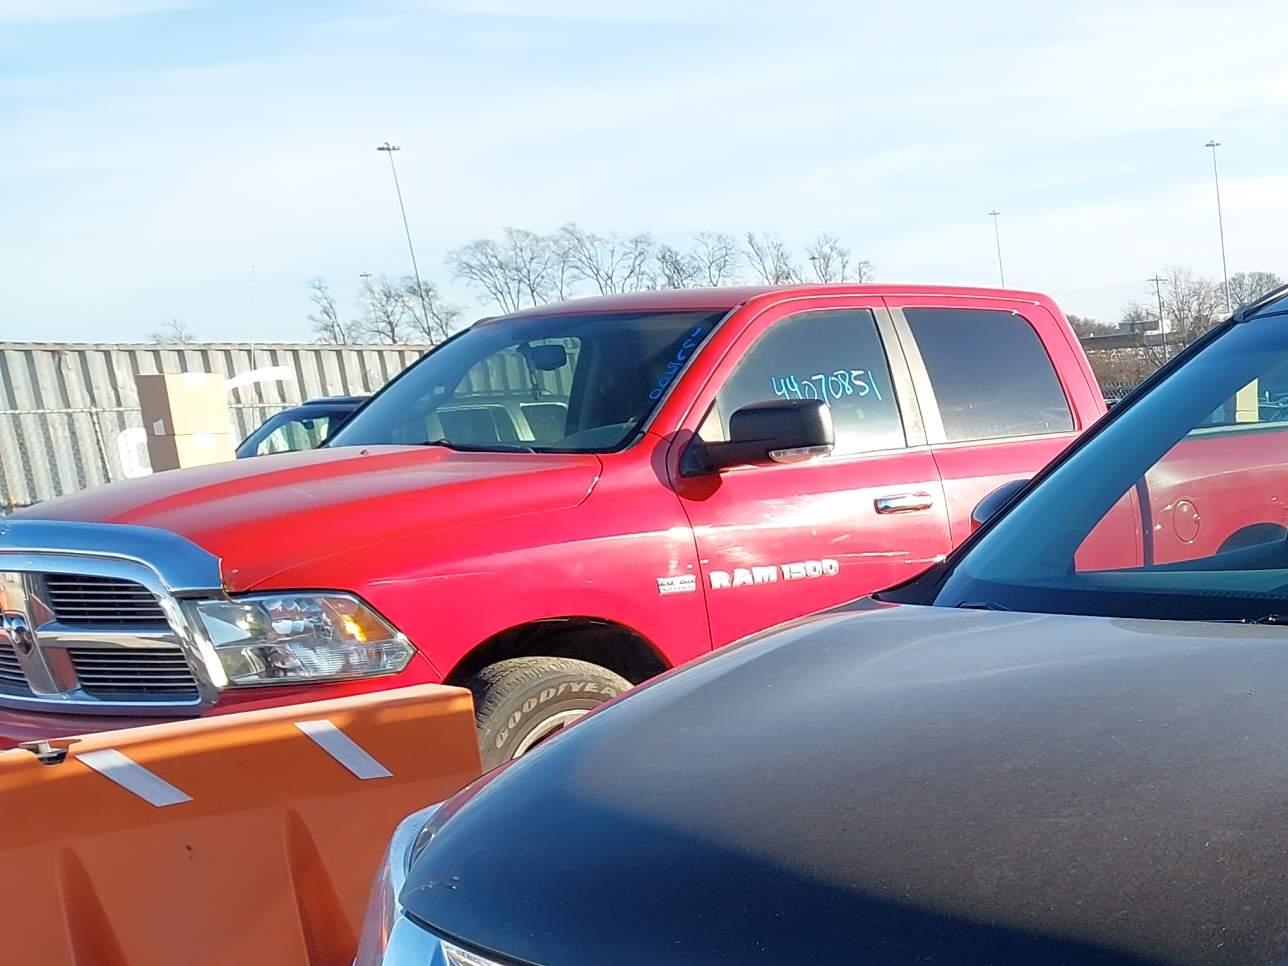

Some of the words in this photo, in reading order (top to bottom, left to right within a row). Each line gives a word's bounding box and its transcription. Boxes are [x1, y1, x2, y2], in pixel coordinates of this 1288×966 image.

[771, 370, 881, 408] 44070851
[709, 565, 778, 590] RAM
[780, 559, 840, 581] 1500
[496, 681, 618, 749] GOODYEA
